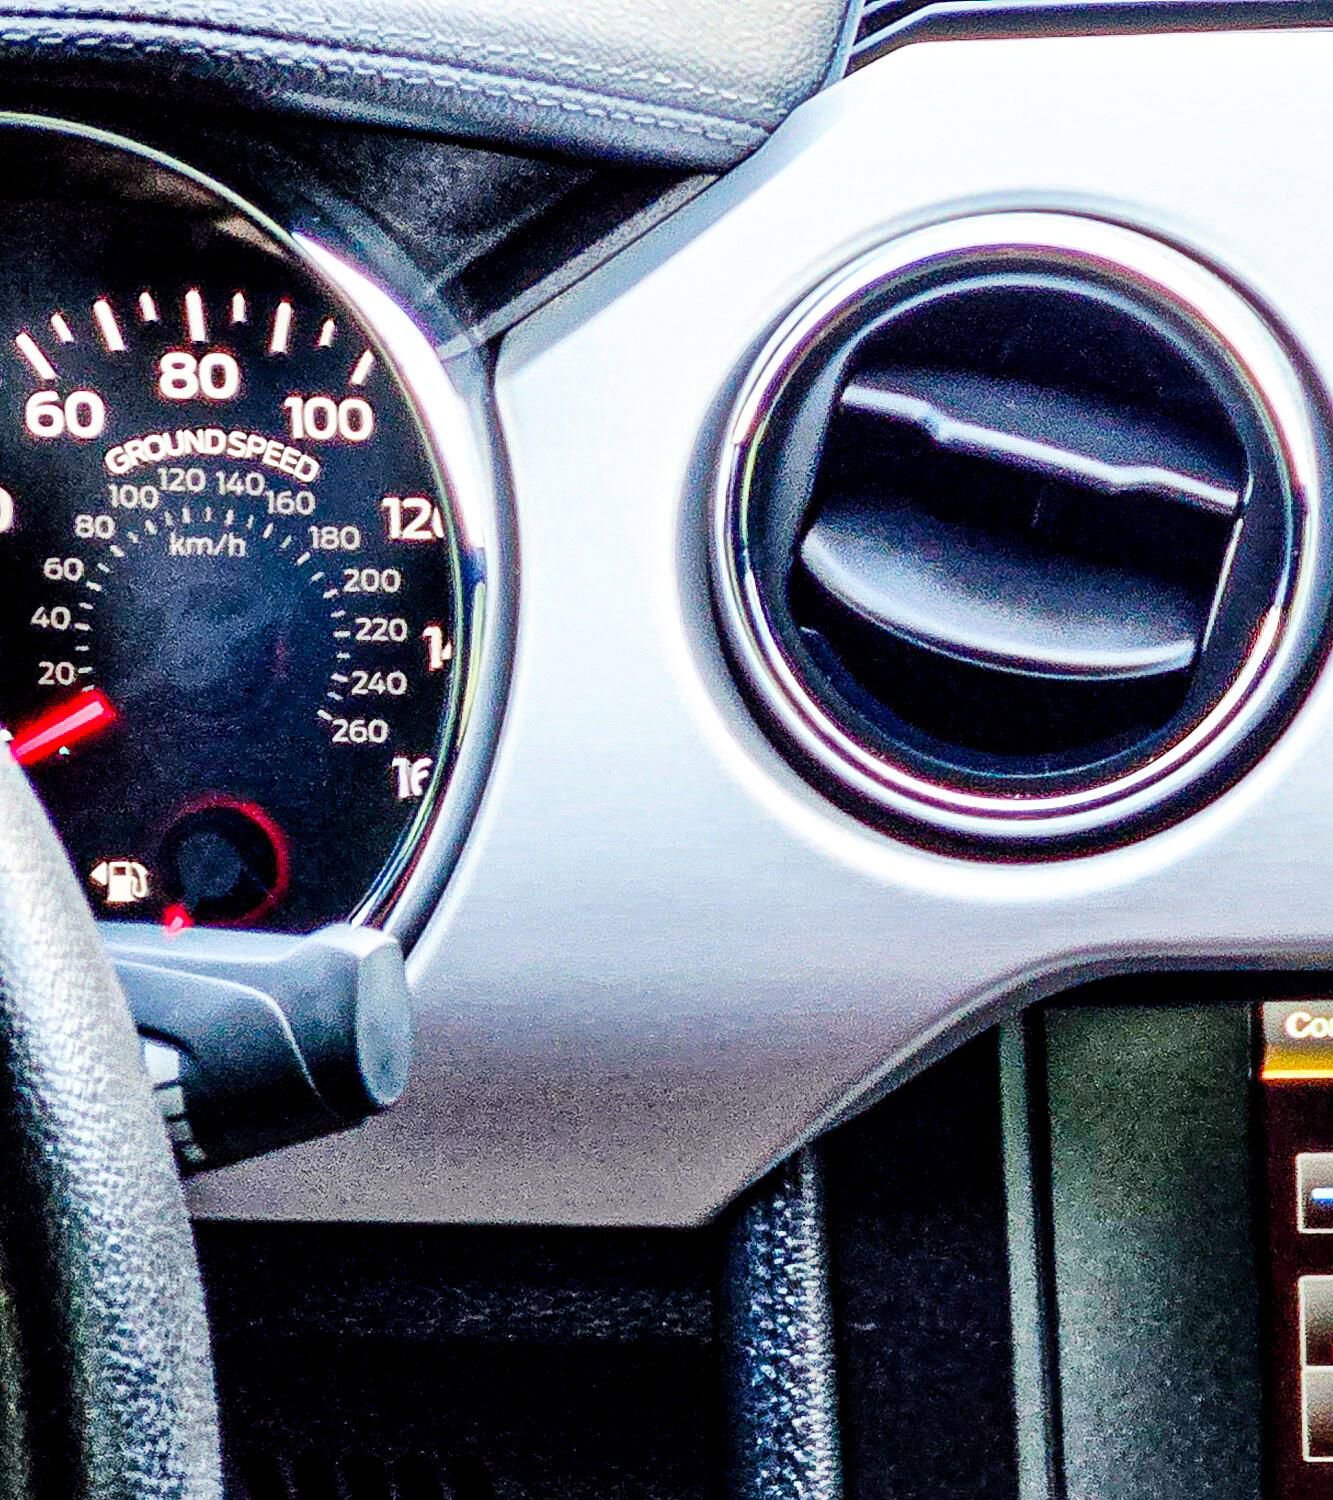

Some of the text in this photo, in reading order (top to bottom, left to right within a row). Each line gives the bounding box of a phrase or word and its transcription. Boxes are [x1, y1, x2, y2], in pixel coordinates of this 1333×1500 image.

[159, 352, 239, 398] 80
[25, 391, 104, 438] 60
[284, 397, 374, 440] 100
[104, 429, 319, 482] GROUND SPEED
[159, 469, 206, 493] 120
[215, 471, 265, 497] 140
[108, 485, 159, 510] 100
[266, 491, 315, 514] 160
[74, 515, 114, 539] 80
[309, 526, 359, 549] 180
[168, 533, 246, 557] km/h
[44, 557, 83, 580] 60
[343, 570, 400, 592] 200
[31, 607, 71, 629] 40
[355, 619, 407, 641] 220
[38, 662, 74, 685] 20
[351, 672, 407, 695] 240
[332, 720, 388, 743] 260
